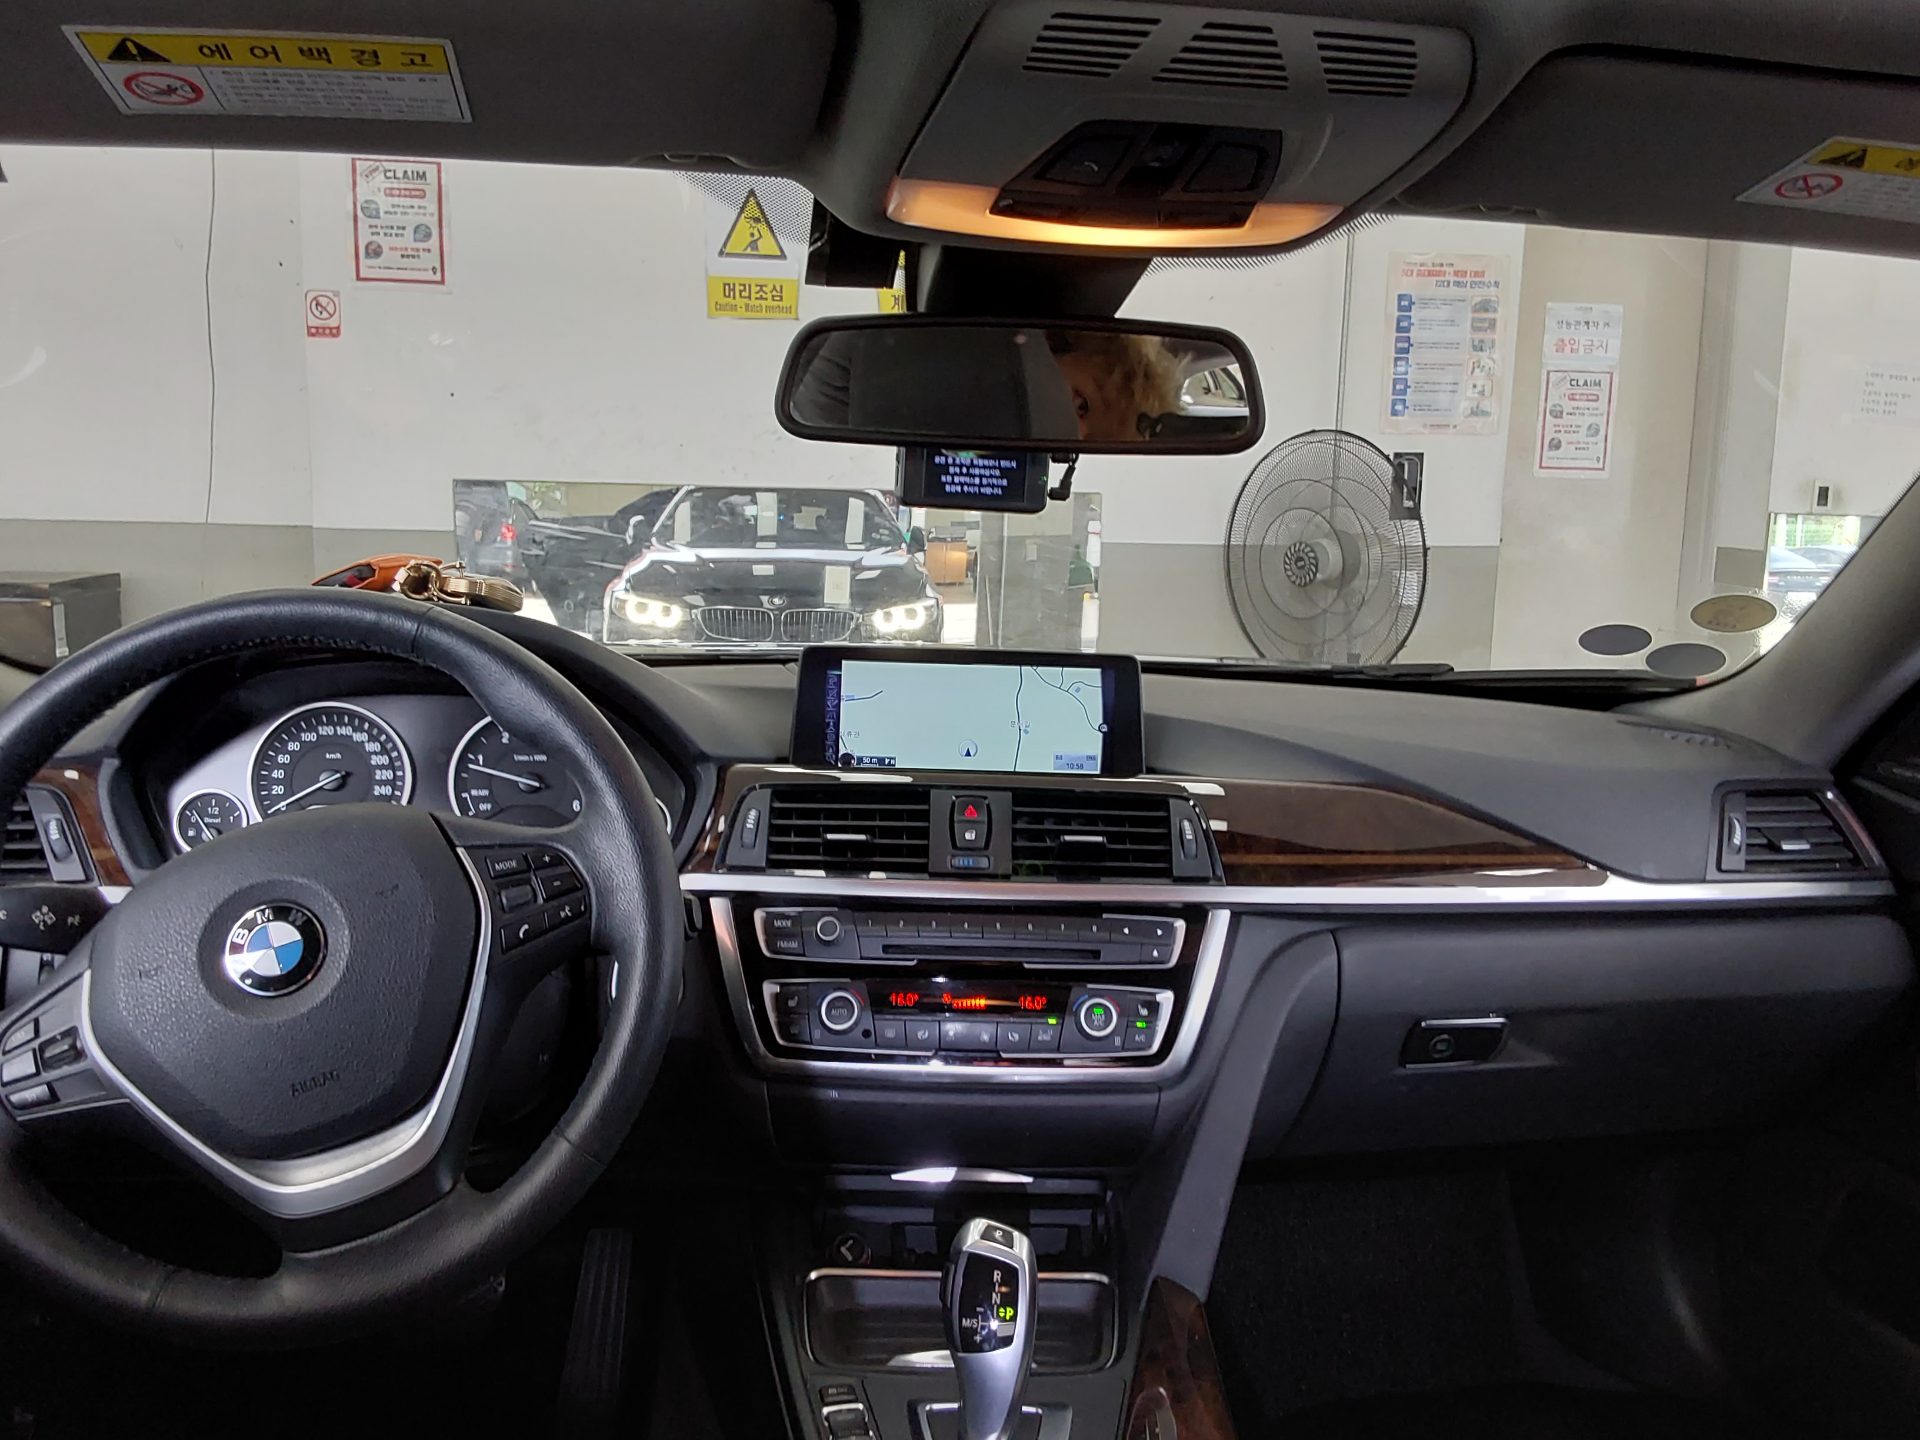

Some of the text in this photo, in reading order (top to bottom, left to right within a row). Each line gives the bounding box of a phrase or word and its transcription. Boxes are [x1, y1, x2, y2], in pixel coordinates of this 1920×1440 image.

[383, 169, 427, 182] CLAIM
[722, 282, 784, 302] 머리조심
[714, 302, 738, 312] Caution
[1569, 378, 1602, 388] CLAIM
[318, 726, 334, 736] 120
[336, 726, 352, 736] 140
[301, 732, 316, 742] 100
[502, 732, 510, 744] 2
[288, 742, 300, 751] 80
[278, 754, 290, 764] 60
[370, 755, 389, 766] 200
[272, 770, 284, 779] 40
[375, 770, 393, 780] 220
[272, 786, 284, 794] 20
[373, 786, 392, 796] 240
[572, 800, 580, 812] 6
[494, 860, 518, 871] MODE
[774, 920, 792, 928] MODE
[993, 1270, 1002, 1282] R
[992, 1292, 1000, 1305] N
[962, 1318, 978, 1328] M/S
